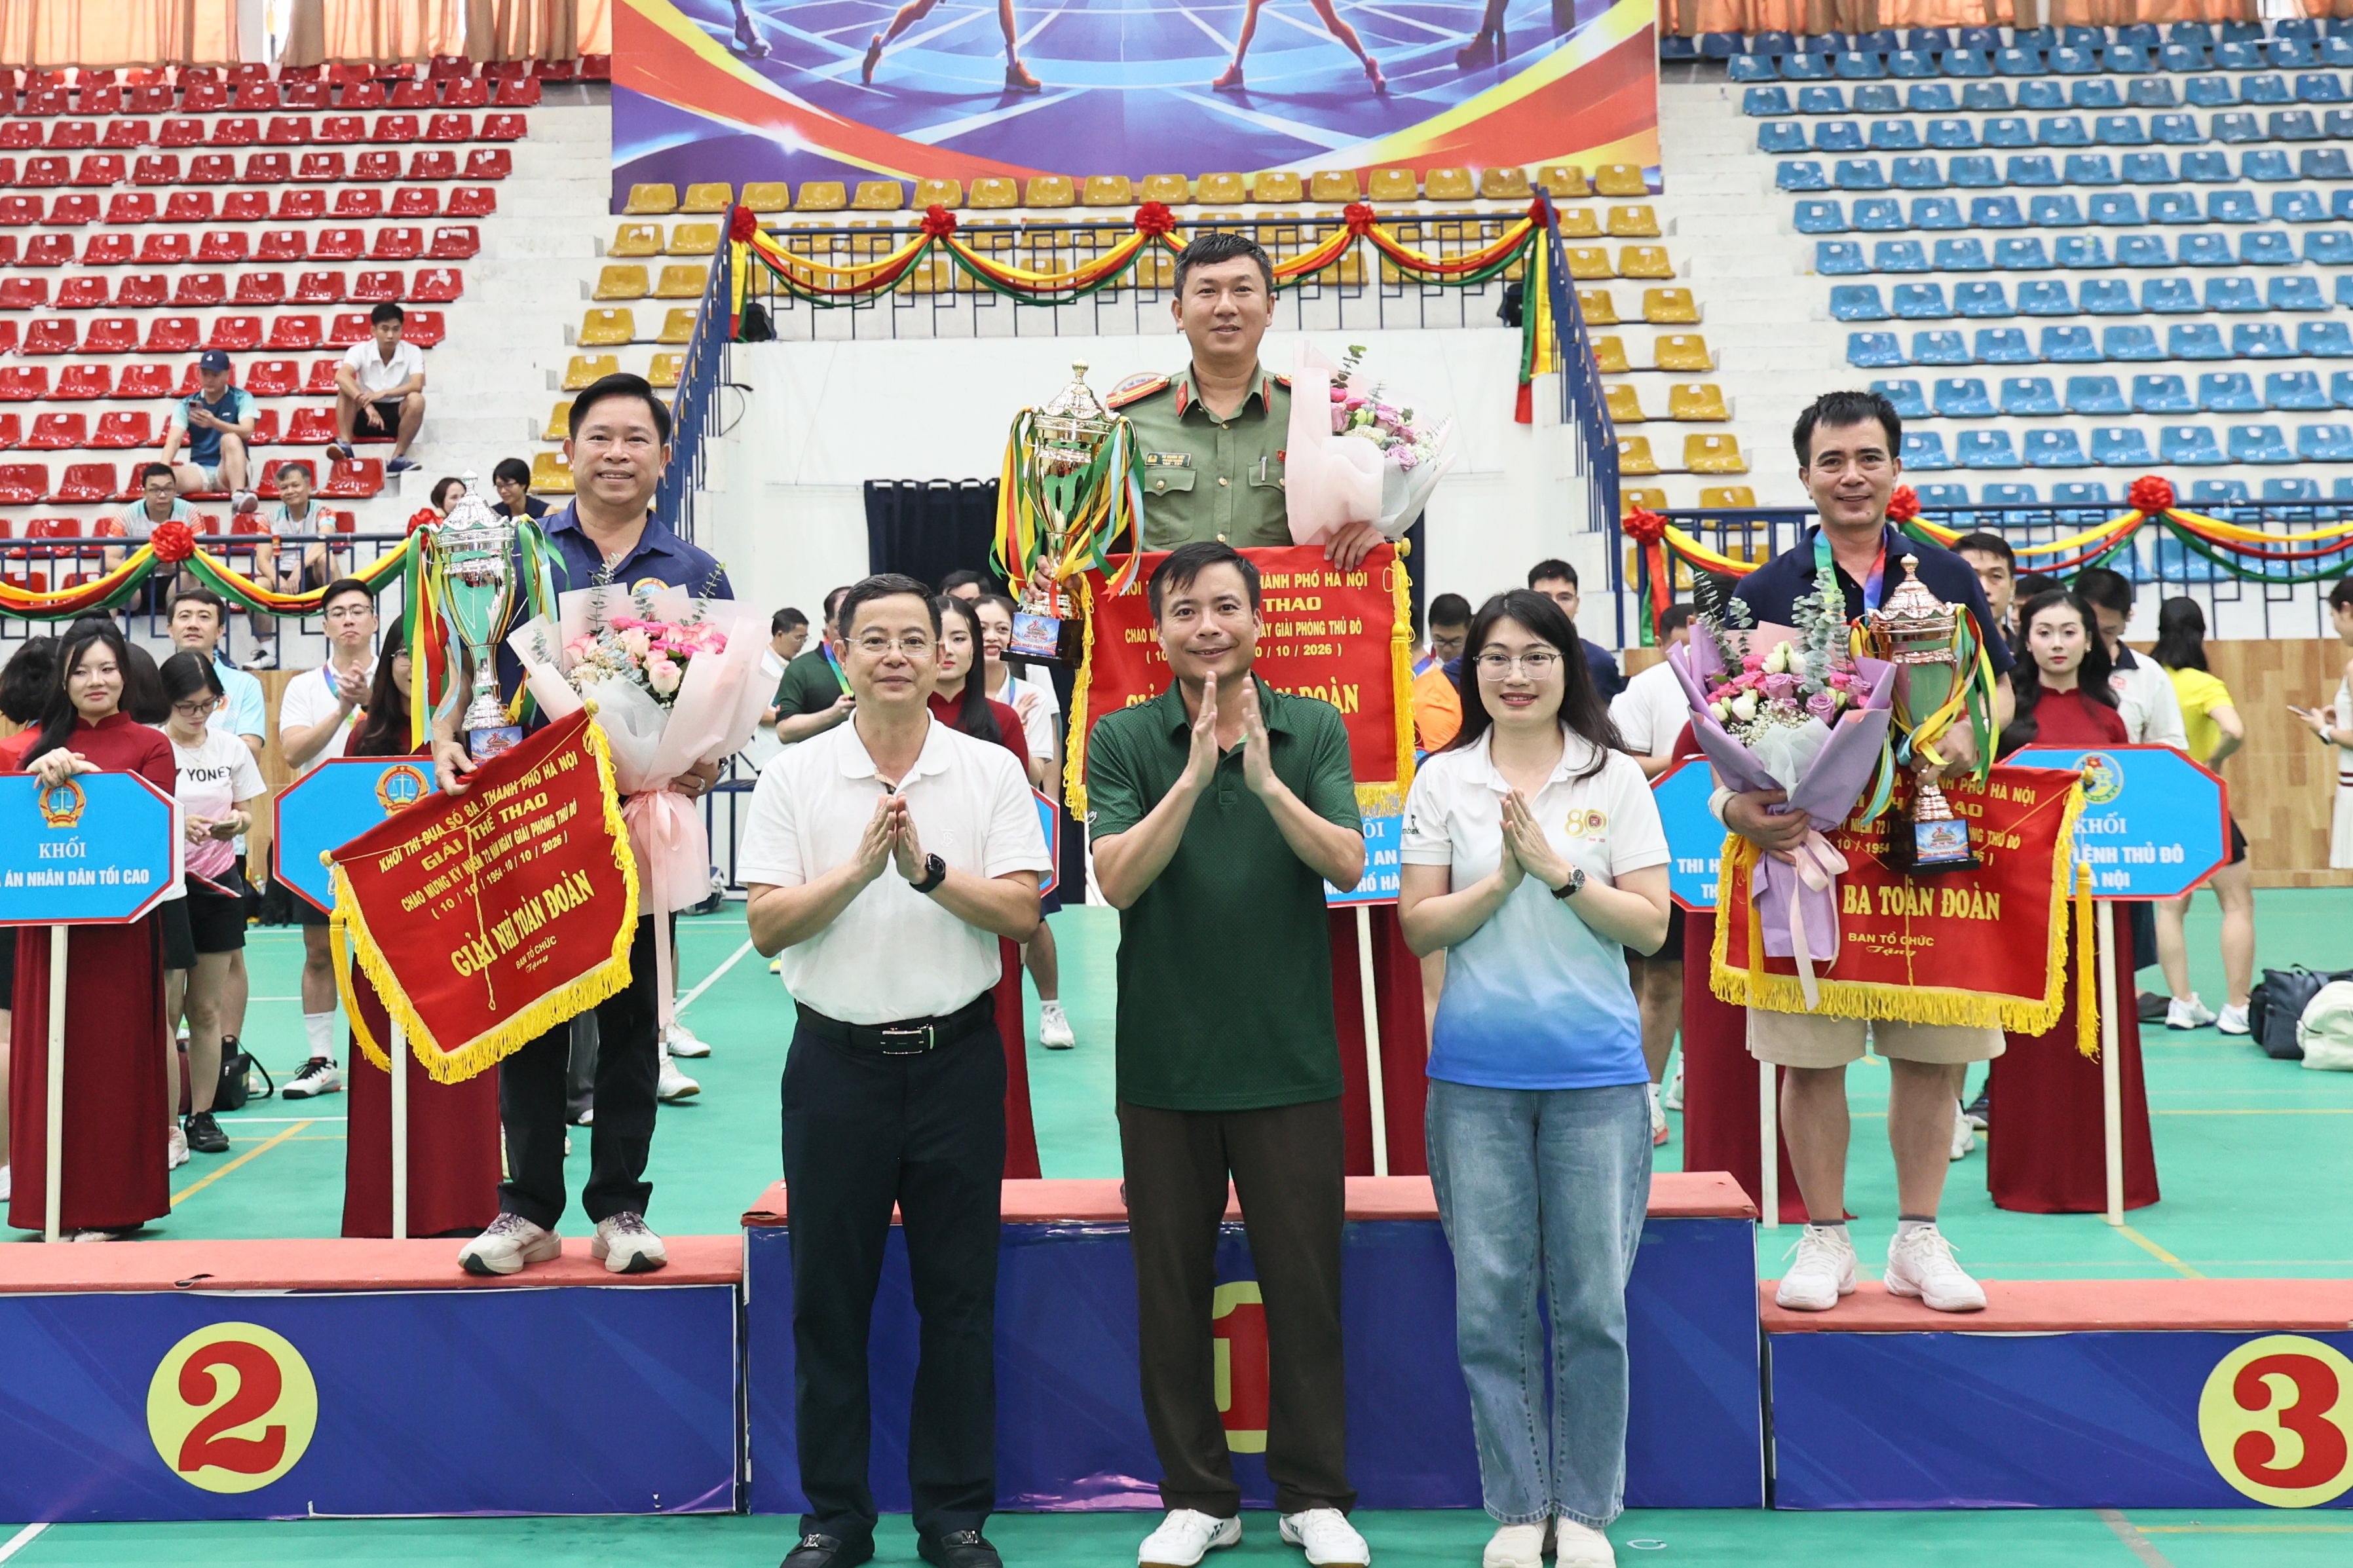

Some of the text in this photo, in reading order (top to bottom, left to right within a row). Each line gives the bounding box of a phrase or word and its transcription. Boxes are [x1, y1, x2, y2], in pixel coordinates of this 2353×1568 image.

[1294, 568, 1320, 588] PHỐ
[1325, 570, 1342, 588] HÀ
[1346, 569, 1368, 590] NỘI
[1262, 597, 1322, 612] THAO
[1125, 626, 1147, 644] CHÀO
[1275, 618, 1292, 637] GIẢI
[1328, 616, 1347, 635] THỦ
[1349, 616, 1362, 635] ĐÔ
[1155, 650, 1168, 662] 10
[1275, 645, 1290, 656] 10
[1303, 644, 1332, 656] 2026
[404, 836, 423, 856] THI
[445, 808, 464, 830] SỐ
[463, 800, 480, 818] 8A
[542, 760, 559, 780] HÀ
[558, 751, 579, 772] NỘI
[1989, 782, 2008, 800] HÀ
[2012, 786, 2037, 807] NỘI
[421, 791, 548, 871] GIẢI THỂ THAO
[38, 835, 87, 859] KHỐI
[401, 890, 426, 912] CHÀO
[448, 863, 464, 883] KỶ
[514, 823, 531, 845] GIẢI
[555, 802, 569, 825] THỦ
[569, 797, 578, 819] ĐÔ
[1374, 849, 1398, 866] AN
[2121, 841, 2156, 864] THỦ
[2159, 843, 2185, 864] ĐÔ
[5, 865, 150, 887] ÁN NHÂN DÂN TỐI CAO
[440, 898, 455, 912] 10
[486, 867, 503, 885] 1954
[505, 859, 514, 872] 10
[519, 849, 532, 863] 10
[541, 835, 563, 854] 2026
[1676, 858, 1704, 874] THI
[1357, 871, 1377, 893] HỐ
[2101, 868, 2131, 891] NỘI
[1843, 878, 2001, 922] BA TOÀN ĐOÀN
[451, 868, 595, 977] GIẢI NHÌ TOÀN ĐOÀN
[1848, 931, 1935, 947] BAN TỔ CHỨC
[516, 954, 527, 970] BAN
[535, 935, 557, 954] CHỨC
[1212, 1303, 1270, 1430] 1
[178, 1341, 286, 1474] 2
[2233, 1354, 2347, 1489] 3
